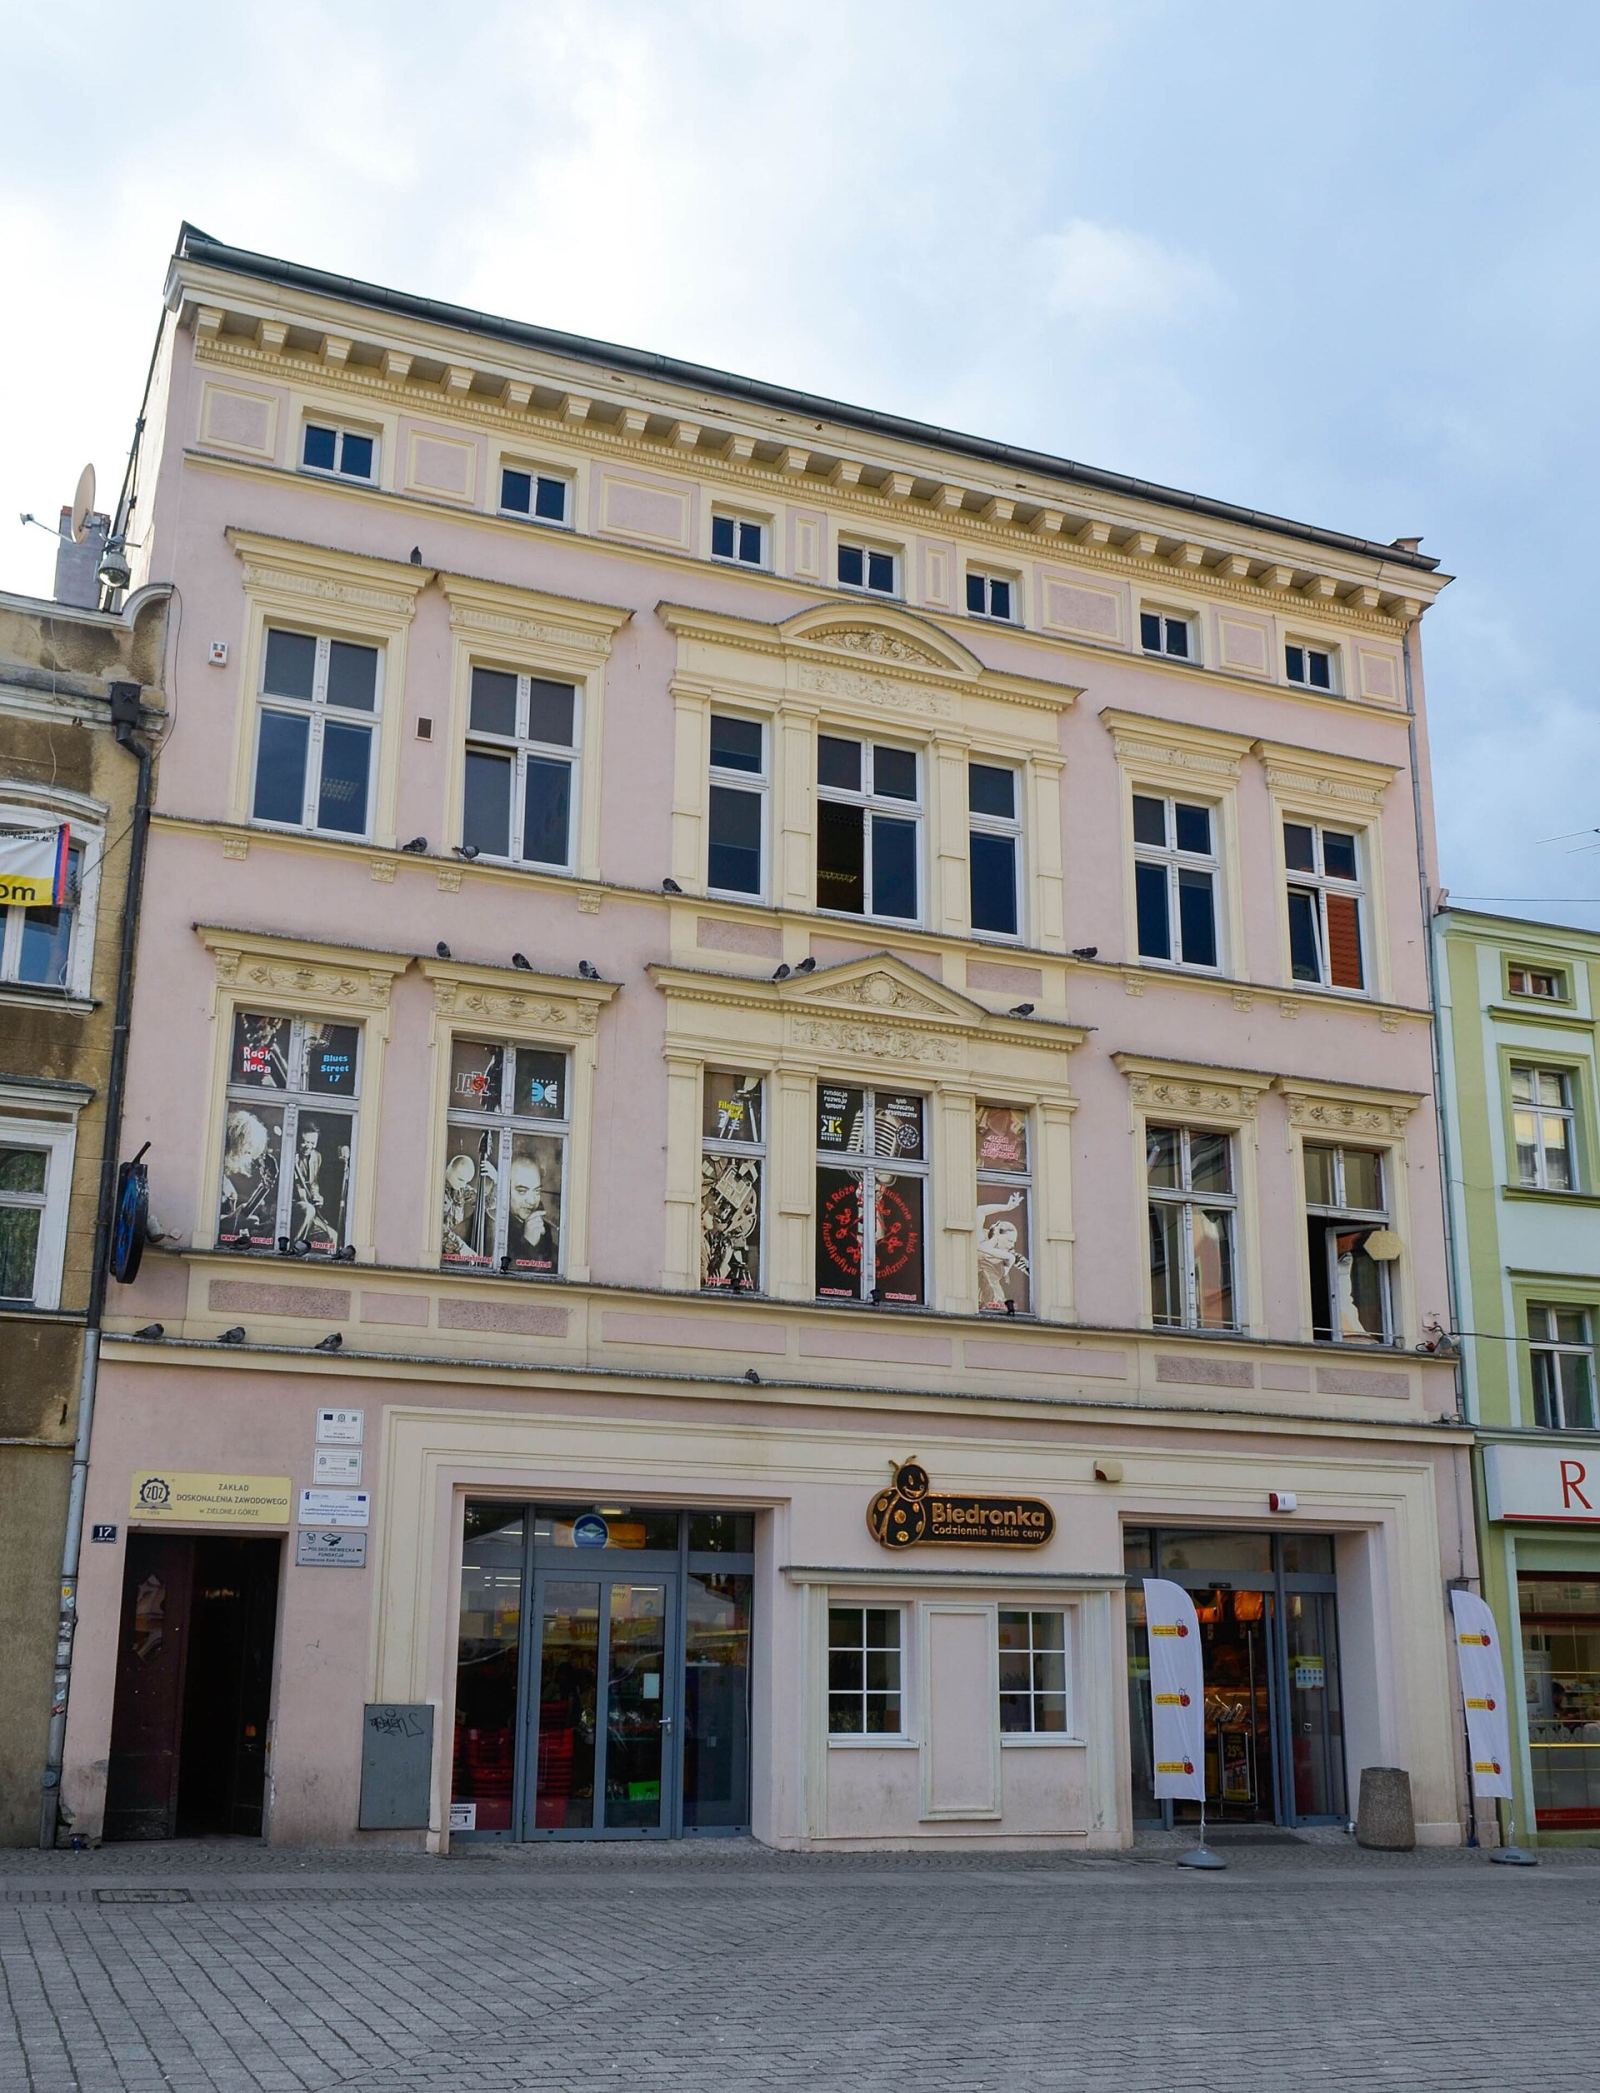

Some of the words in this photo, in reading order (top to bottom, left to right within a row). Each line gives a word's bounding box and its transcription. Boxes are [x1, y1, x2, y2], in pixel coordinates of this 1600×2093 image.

[243, 1046, 271, 1060] Rock
[323, 1054, 348, 1063] Blues
[320, 1064, 349, 1072] Street
[218, 1483, 249, 1492] ZAKŁAD
[1559, 1460, 1593, 1510] R
[146, 1485, 164, 1500] ZDZ
[176, 1493, 233, 1503] DOSKONALENIA
[234, 1495, 288, 1505] ZAWODOWEGO
[931, 1502, 1045, 1527] Biedronka
[99, 1526, 112, 1537] 17
[931, 1523, 987, 1536] Codziennie
[991, 1526, 1019, 1537] niskie
[1022, 1529, 1045, 1540] ceny
